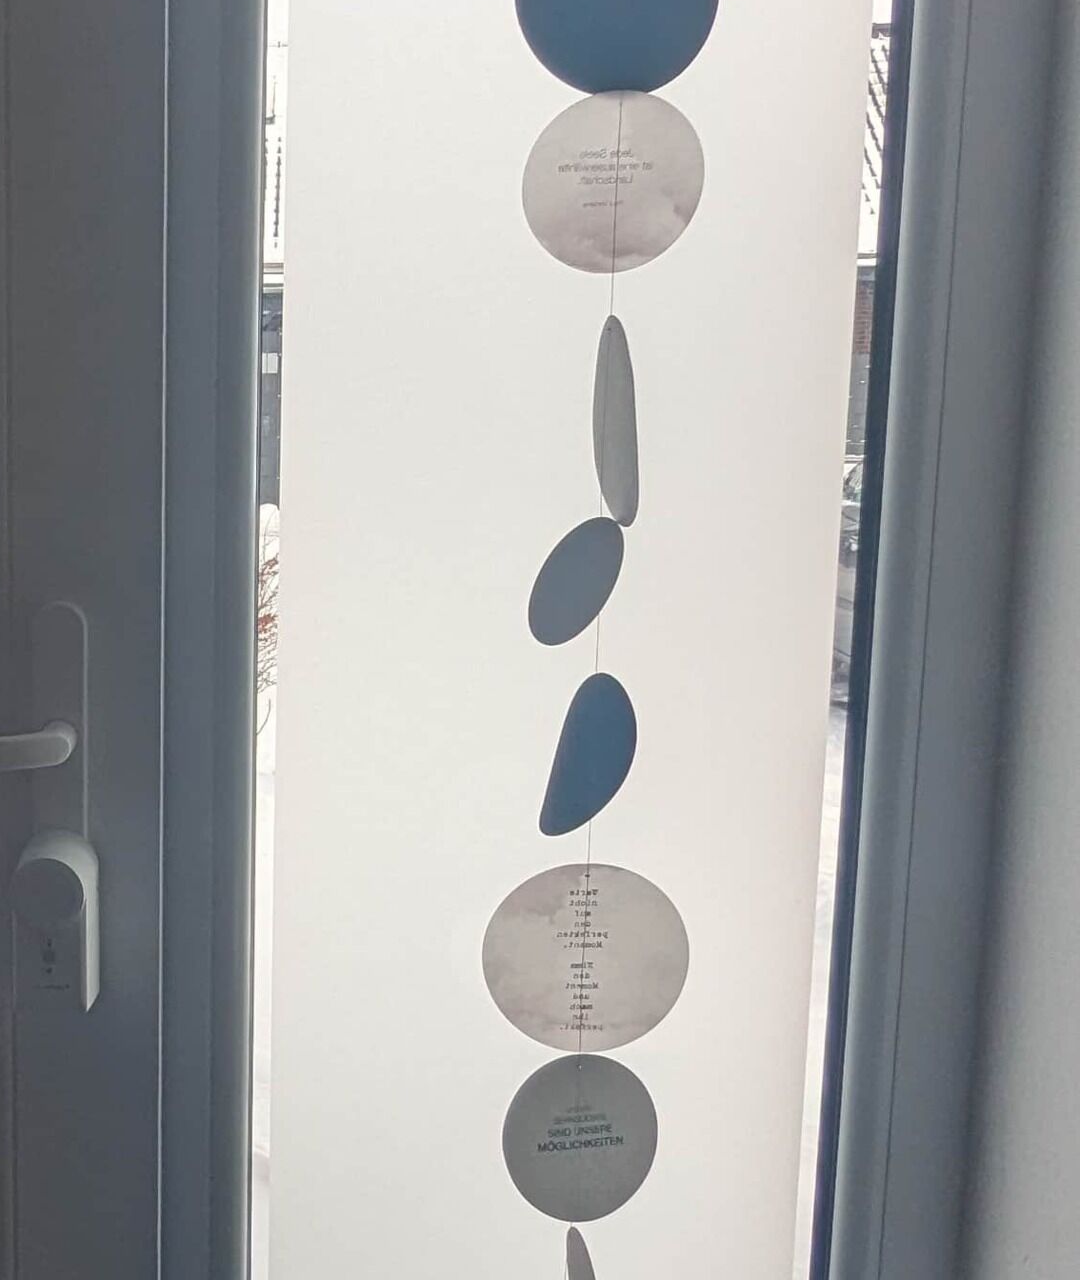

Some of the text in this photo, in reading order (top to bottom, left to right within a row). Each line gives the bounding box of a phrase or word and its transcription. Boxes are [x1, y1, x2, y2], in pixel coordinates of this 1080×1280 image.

[547, 1123, 613, 1138] SIND UNSERE
[536, 1135, 625, 1152] MÖGLICHKEITEN
